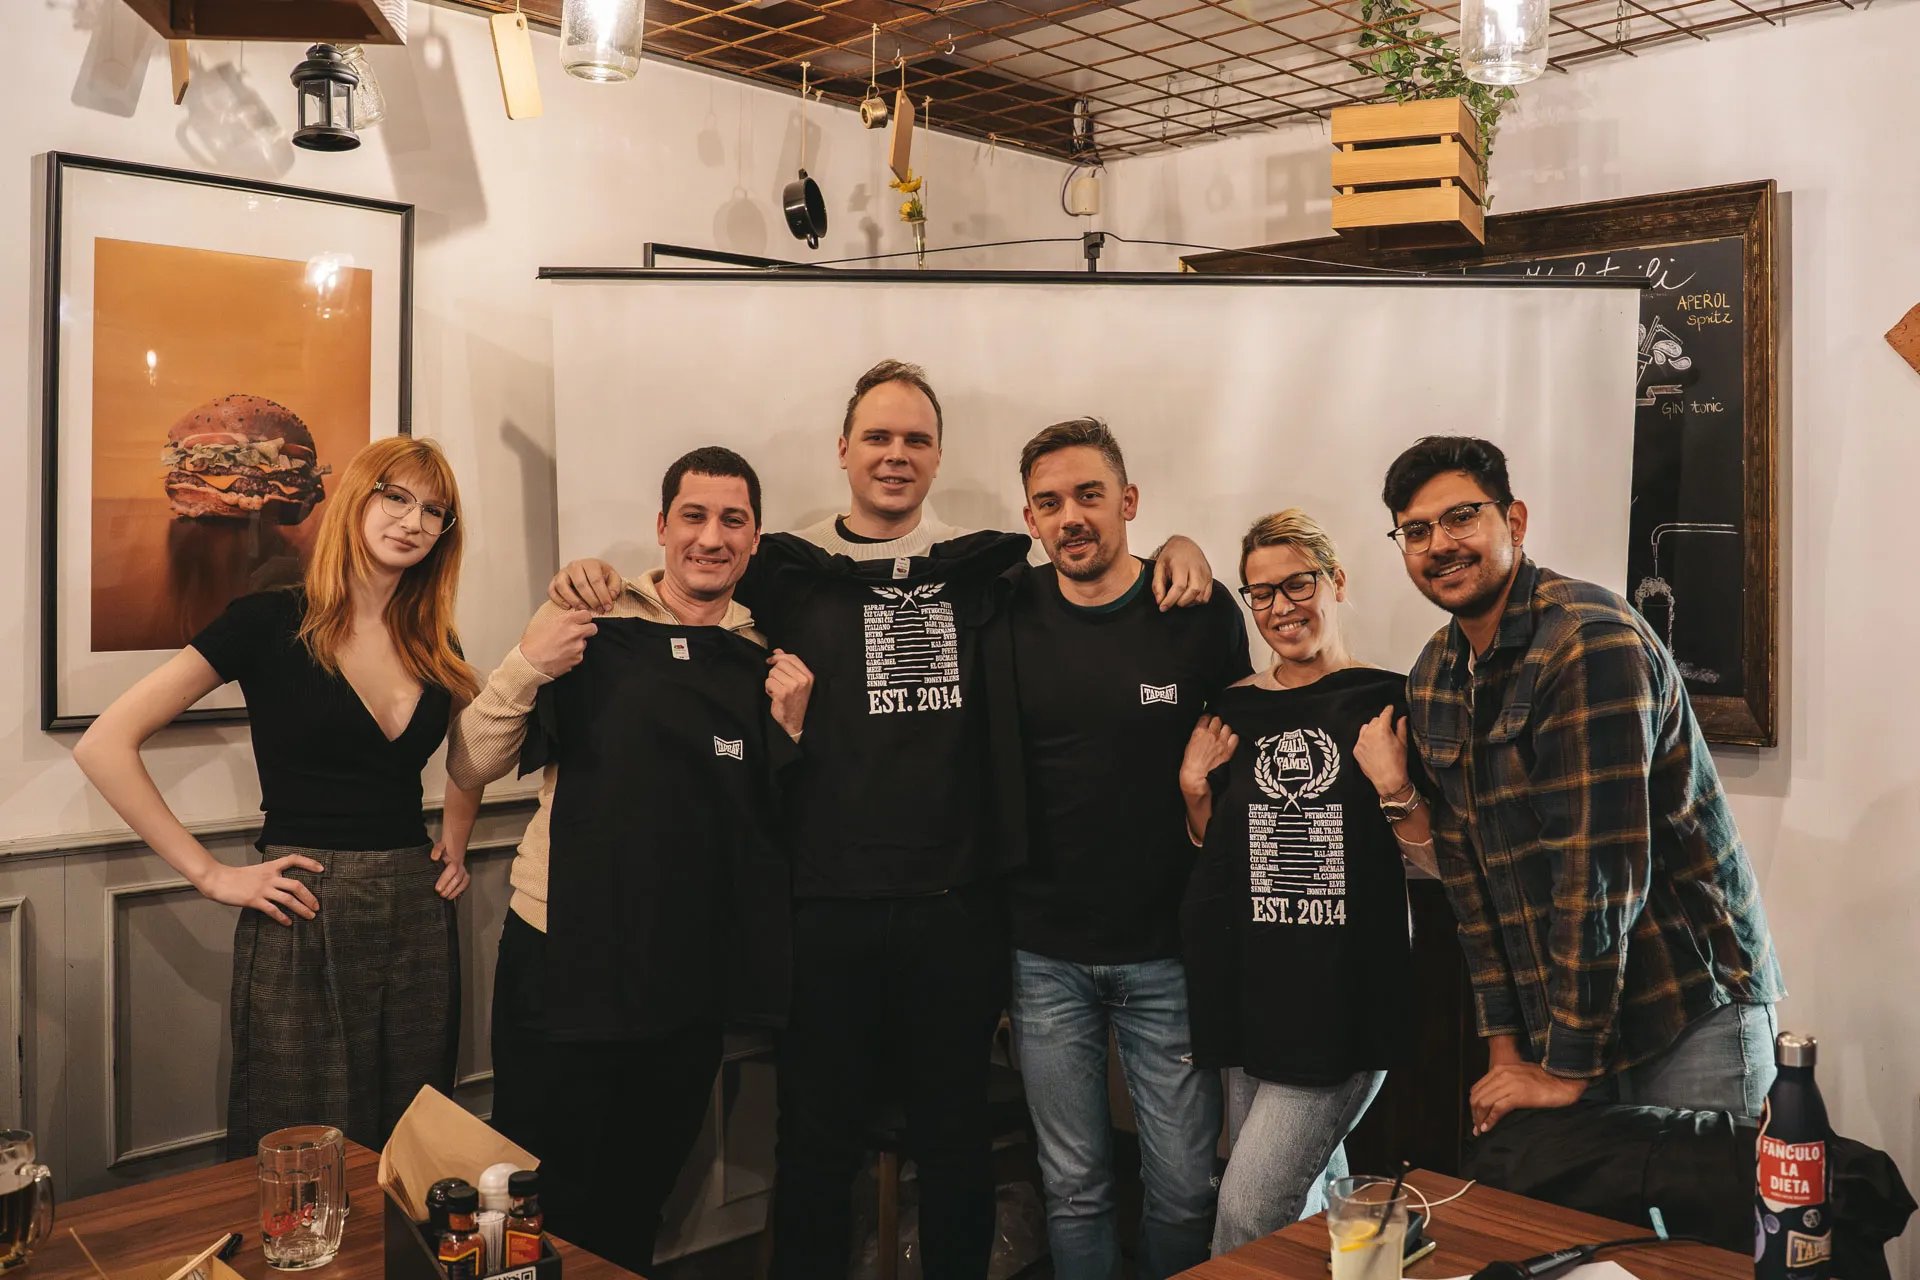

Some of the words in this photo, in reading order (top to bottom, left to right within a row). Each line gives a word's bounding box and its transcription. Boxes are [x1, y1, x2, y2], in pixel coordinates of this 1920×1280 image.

[1677, 292, 1731, 311] APEROL
[1686, 311, 1733, 331] spritz
[1662, 401, 1684, 417] GIN
[1690, 397, 1724, 414] tonic
[868, 688, 913, 714] EST.
[917, 685, 963, 711] 2014
[1144, 688, 1174, 701] TAPRAV
[717, 740, 740, 756] TAPRAV
[1279, 739, 1305, 753] HALL
[1277, 758, 1310, 771] FAME
[1251, 864, 1279, 872] GARGAMEL
[1251, 897, 1293, 924] EST.
[1298, 899, 1346, 925] 2014
[1763, 1141, 1820, 1161] FANCULO
[1781, 1162, 1799, 1177] LA
[1770, 1176, 1810, 1194] DIETA
